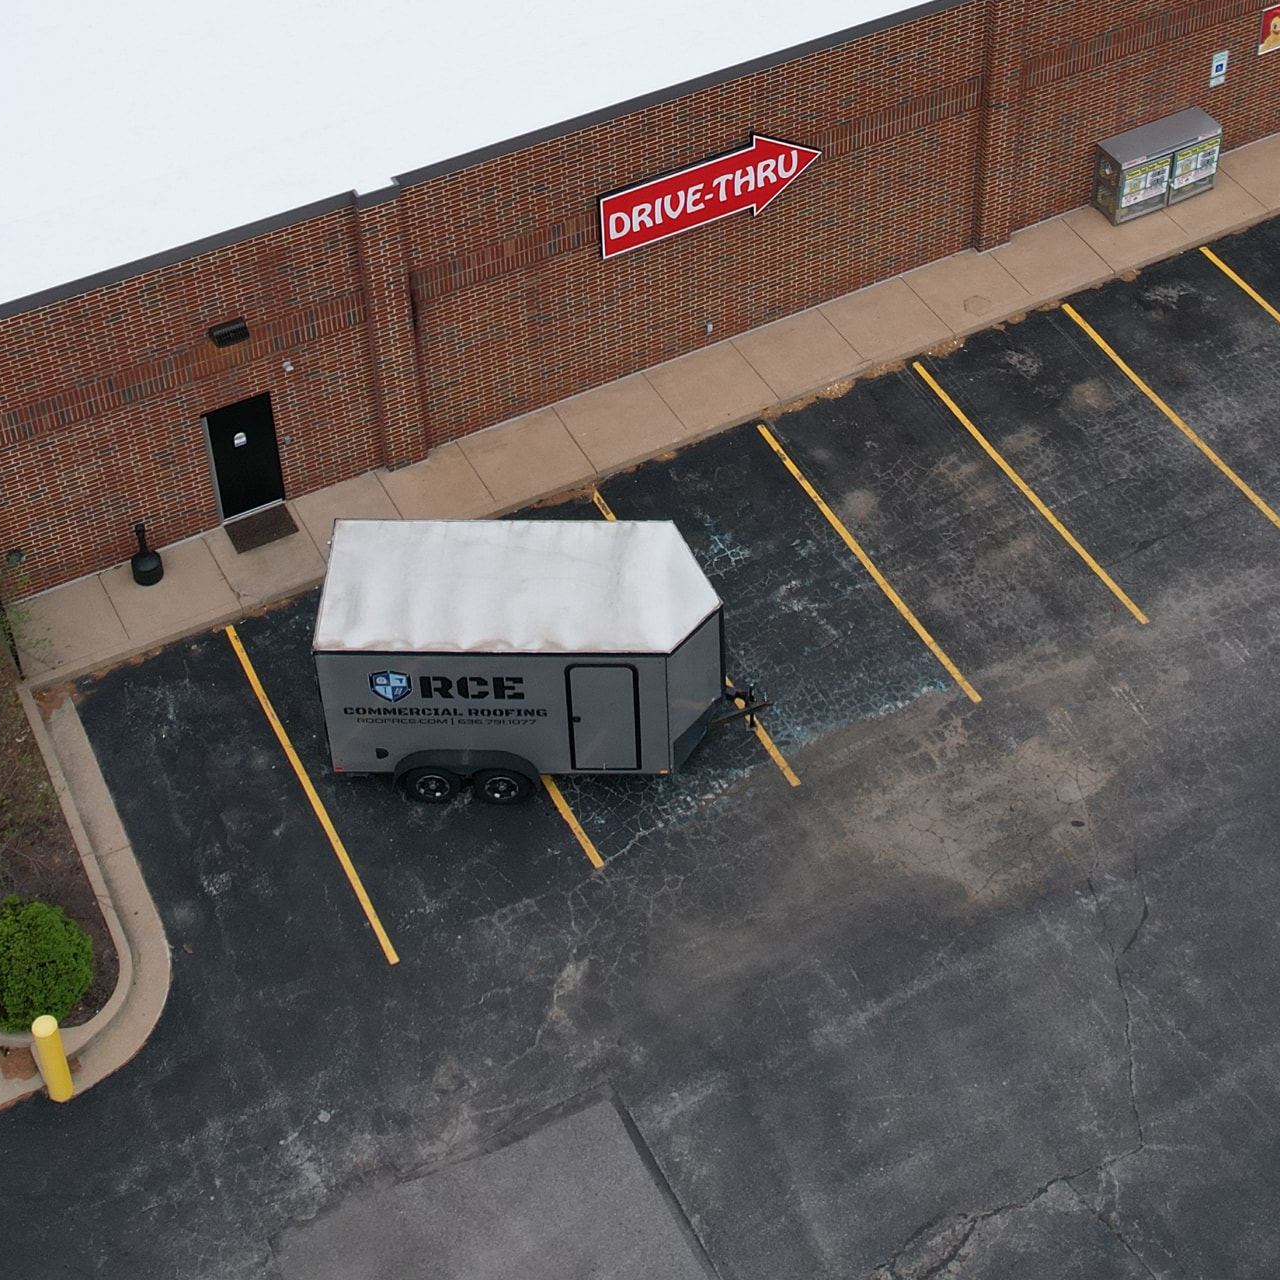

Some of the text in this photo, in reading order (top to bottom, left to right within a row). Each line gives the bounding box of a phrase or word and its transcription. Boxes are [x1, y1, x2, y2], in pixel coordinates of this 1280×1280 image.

[609, 150, 799, 240] DRIVE-THRU
[420, 676, 525, 700] RCE
[343, 706, 548, 717] COMMERCIAL ROOFING
